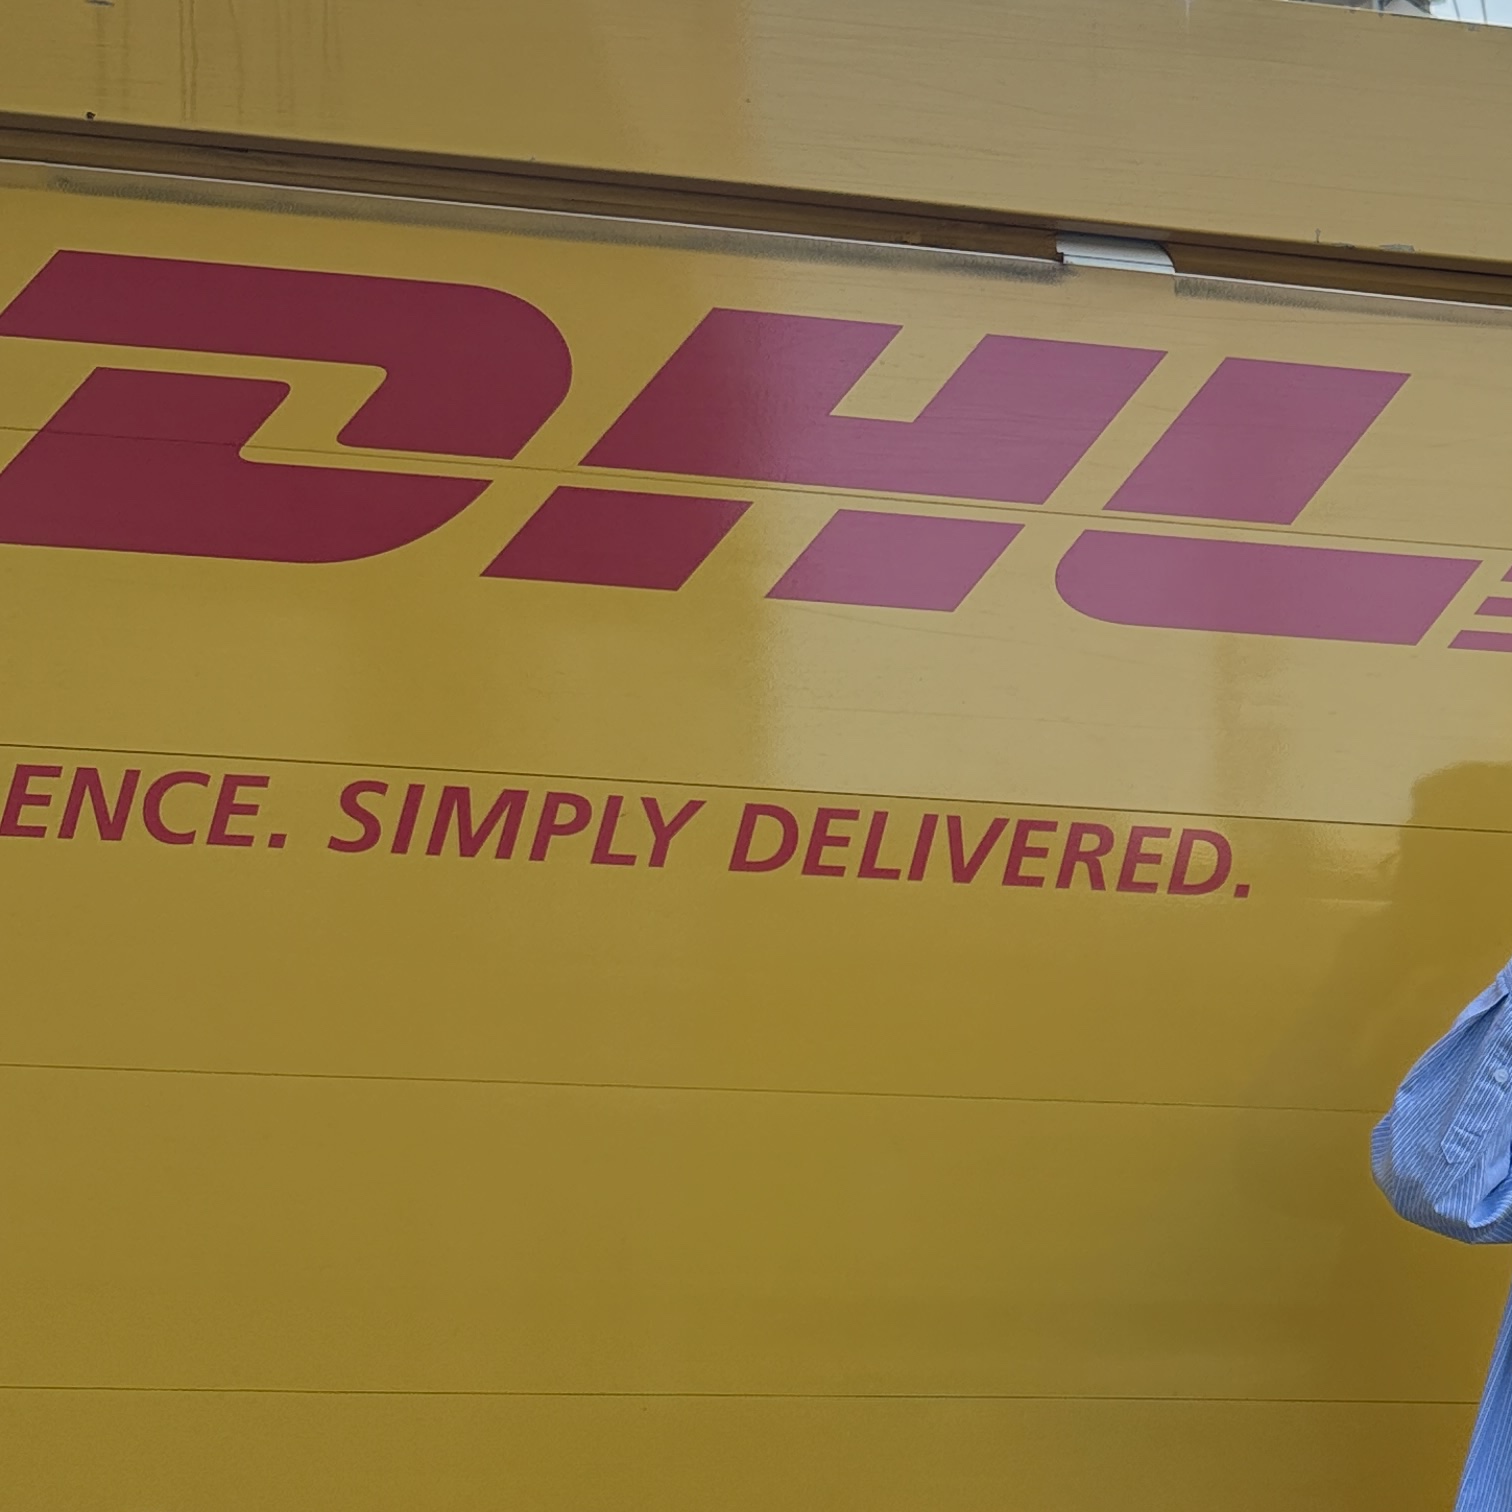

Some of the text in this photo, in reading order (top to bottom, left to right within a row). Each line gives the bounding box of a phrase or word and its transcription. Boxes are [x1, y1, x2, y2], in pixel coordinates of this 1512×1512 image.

[0, 248, 1484, 647] DHL
[0, 763, 1251, 898] ENCE. SIMPLY DELIVERED.
